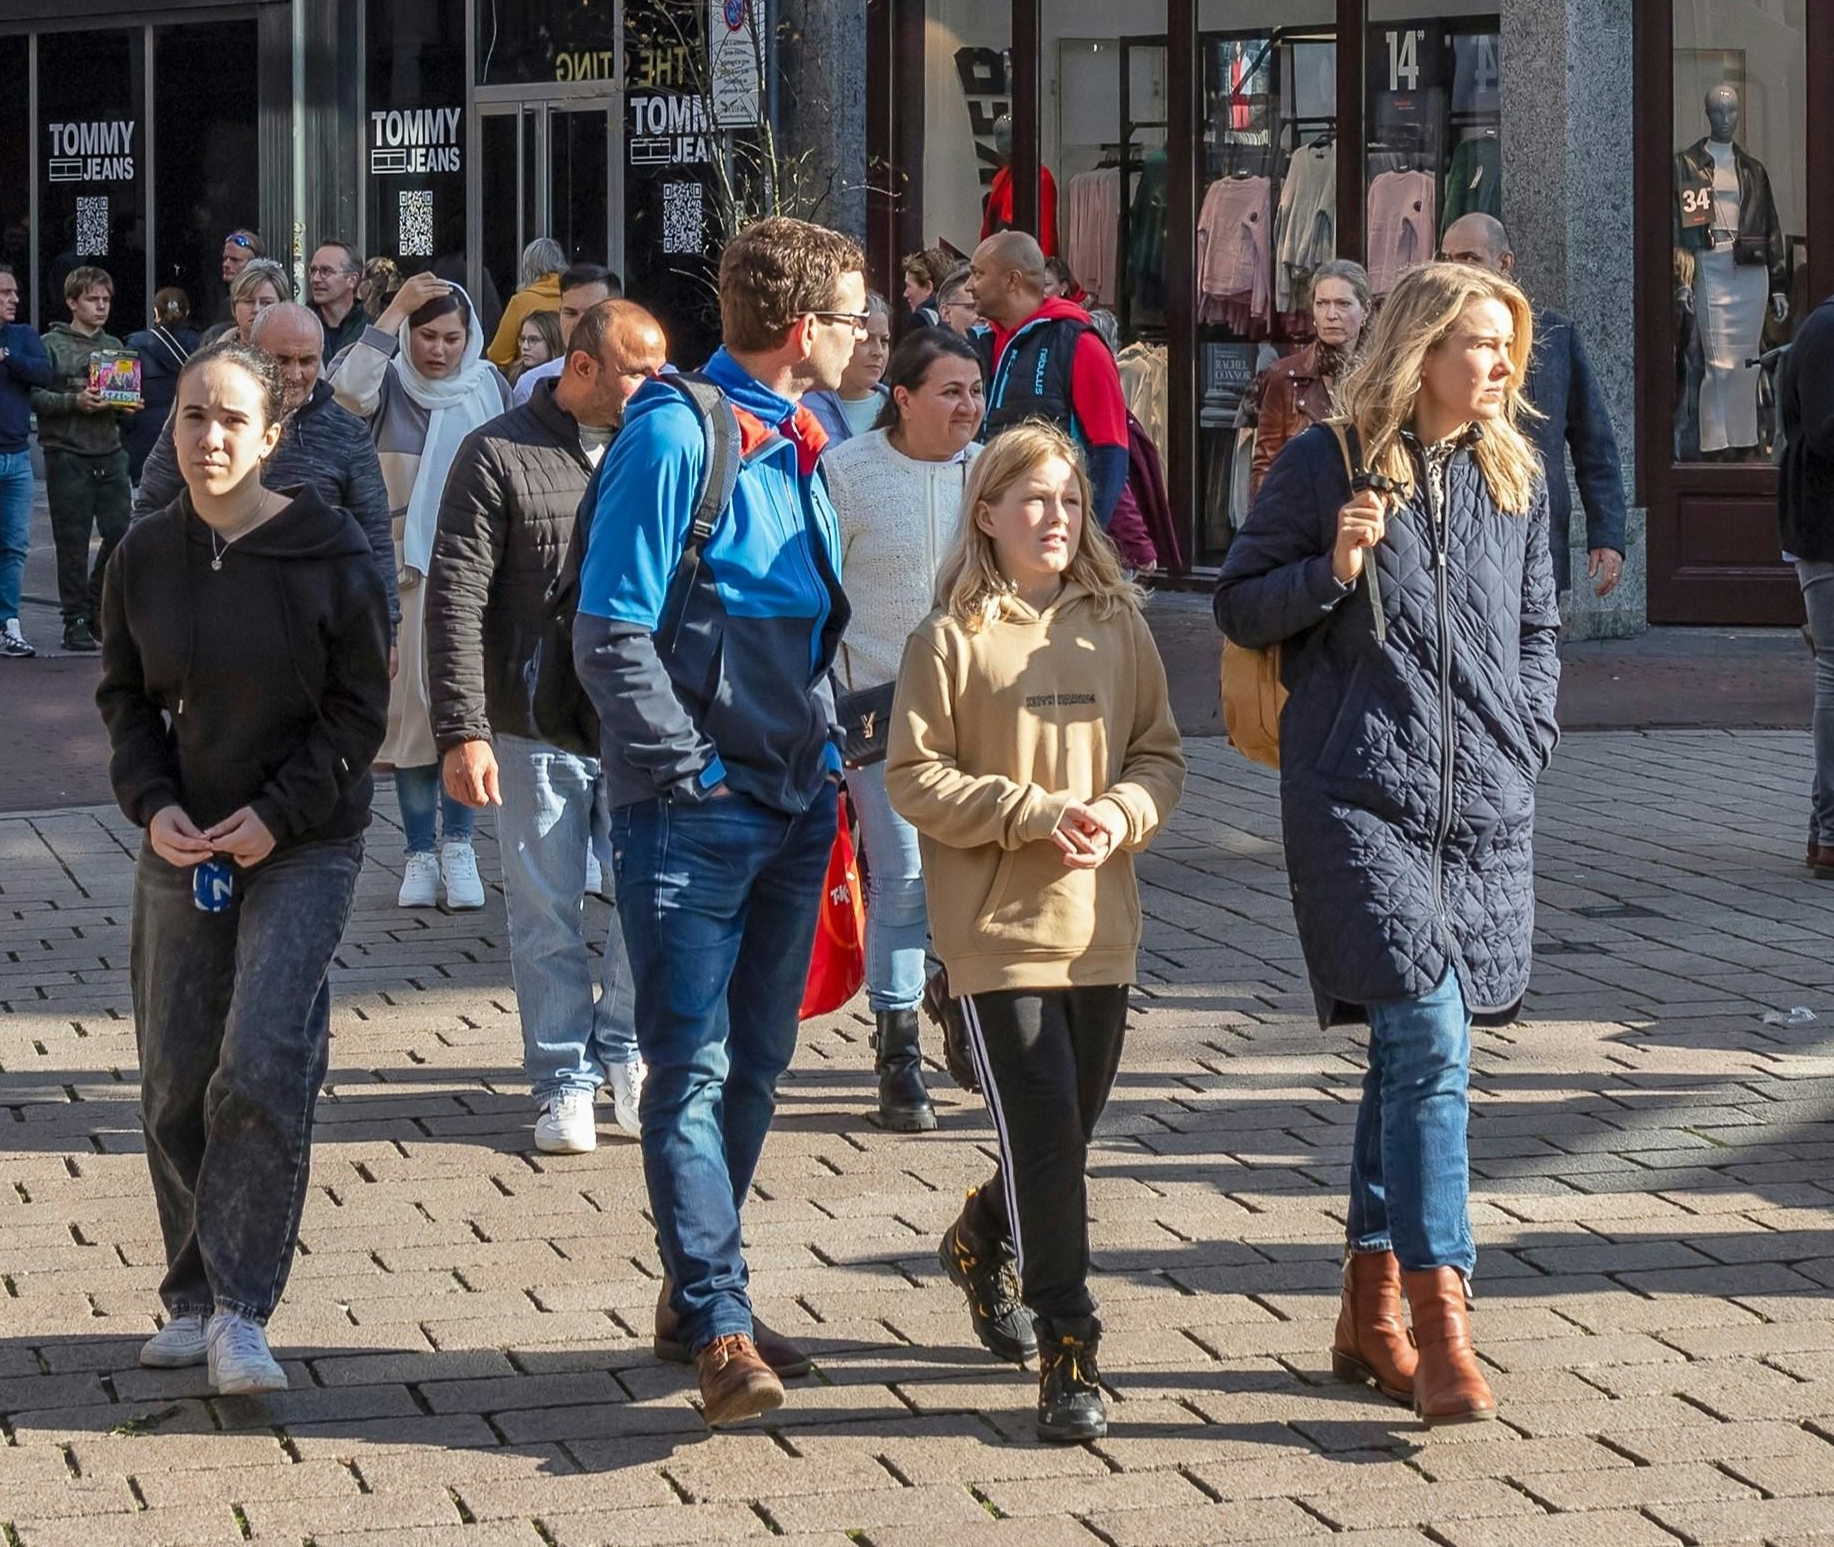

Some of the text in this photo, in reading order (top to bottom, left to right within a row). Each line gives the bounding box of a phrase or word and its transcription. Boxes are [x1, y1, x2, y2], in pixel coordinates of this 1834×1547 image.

[49, 121, 135, 156] TOMMY
[371, 107, 461, 147] TOMMY
[83, 157, 135, 181] JEANS
[407, 146, 461, 173] JEANS
[1682, 188, 1711, 213] 34
